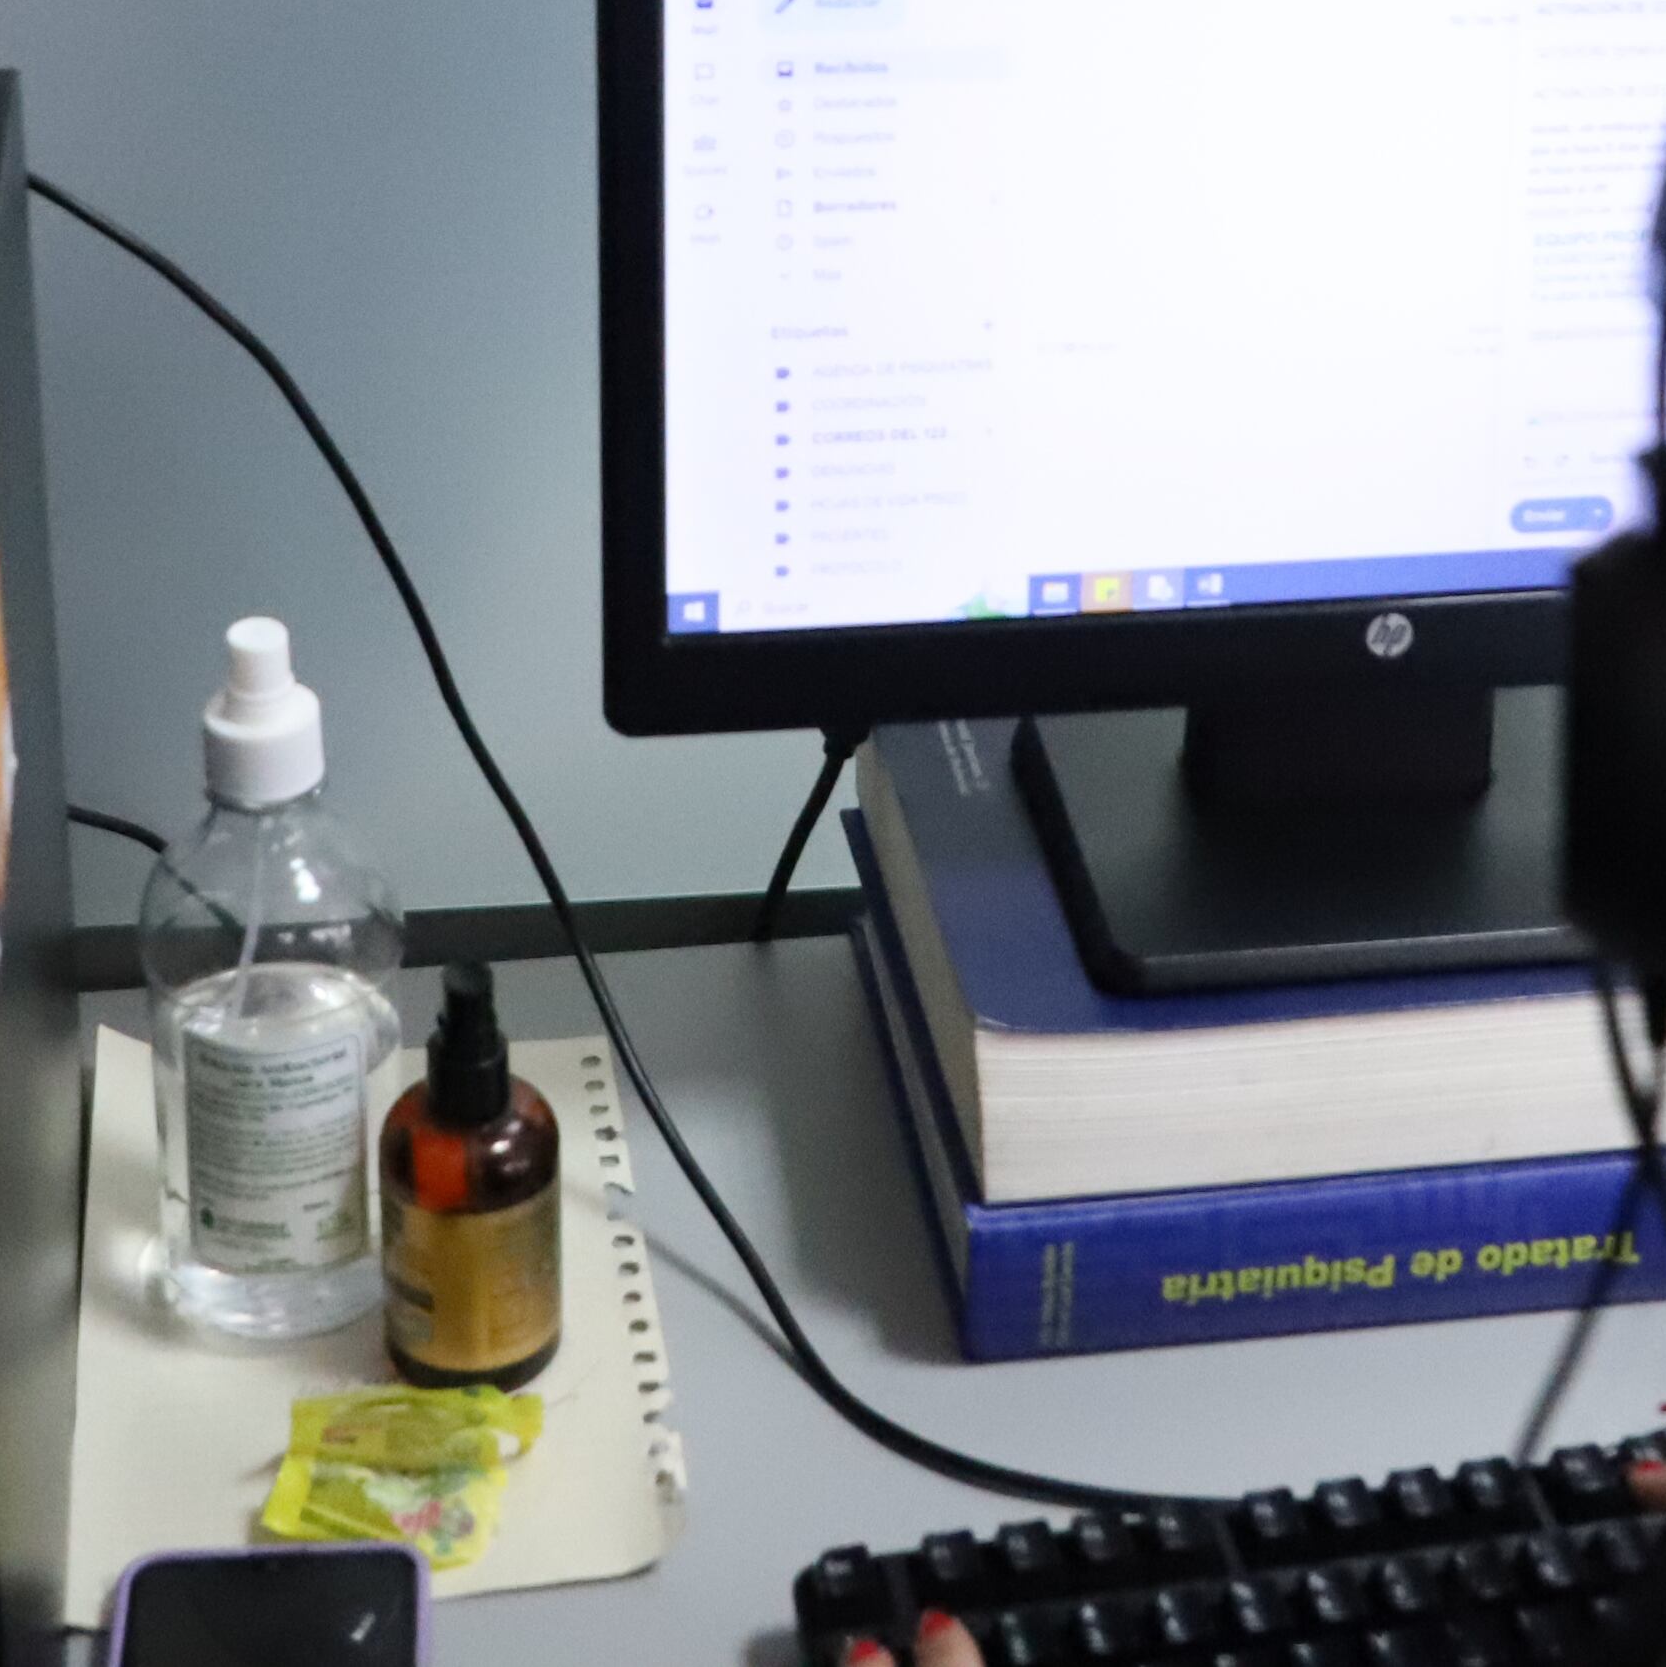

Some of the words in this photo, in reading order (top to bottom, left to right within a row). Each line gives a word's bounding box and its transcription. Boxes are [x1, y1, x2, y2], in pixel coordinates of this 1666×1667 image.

[813, 60, 889, 76] Recibidos
[812, 200, 897, 214] Borradores
[770, 324, 849, 340] Etiquetas
[812, 428, 885, 444] CORREOS
[890, 427, 917, 441] DEL
[1476, 1232, 1640, 1276] Tratado
[1410, 1248, 1464, 1282] de
